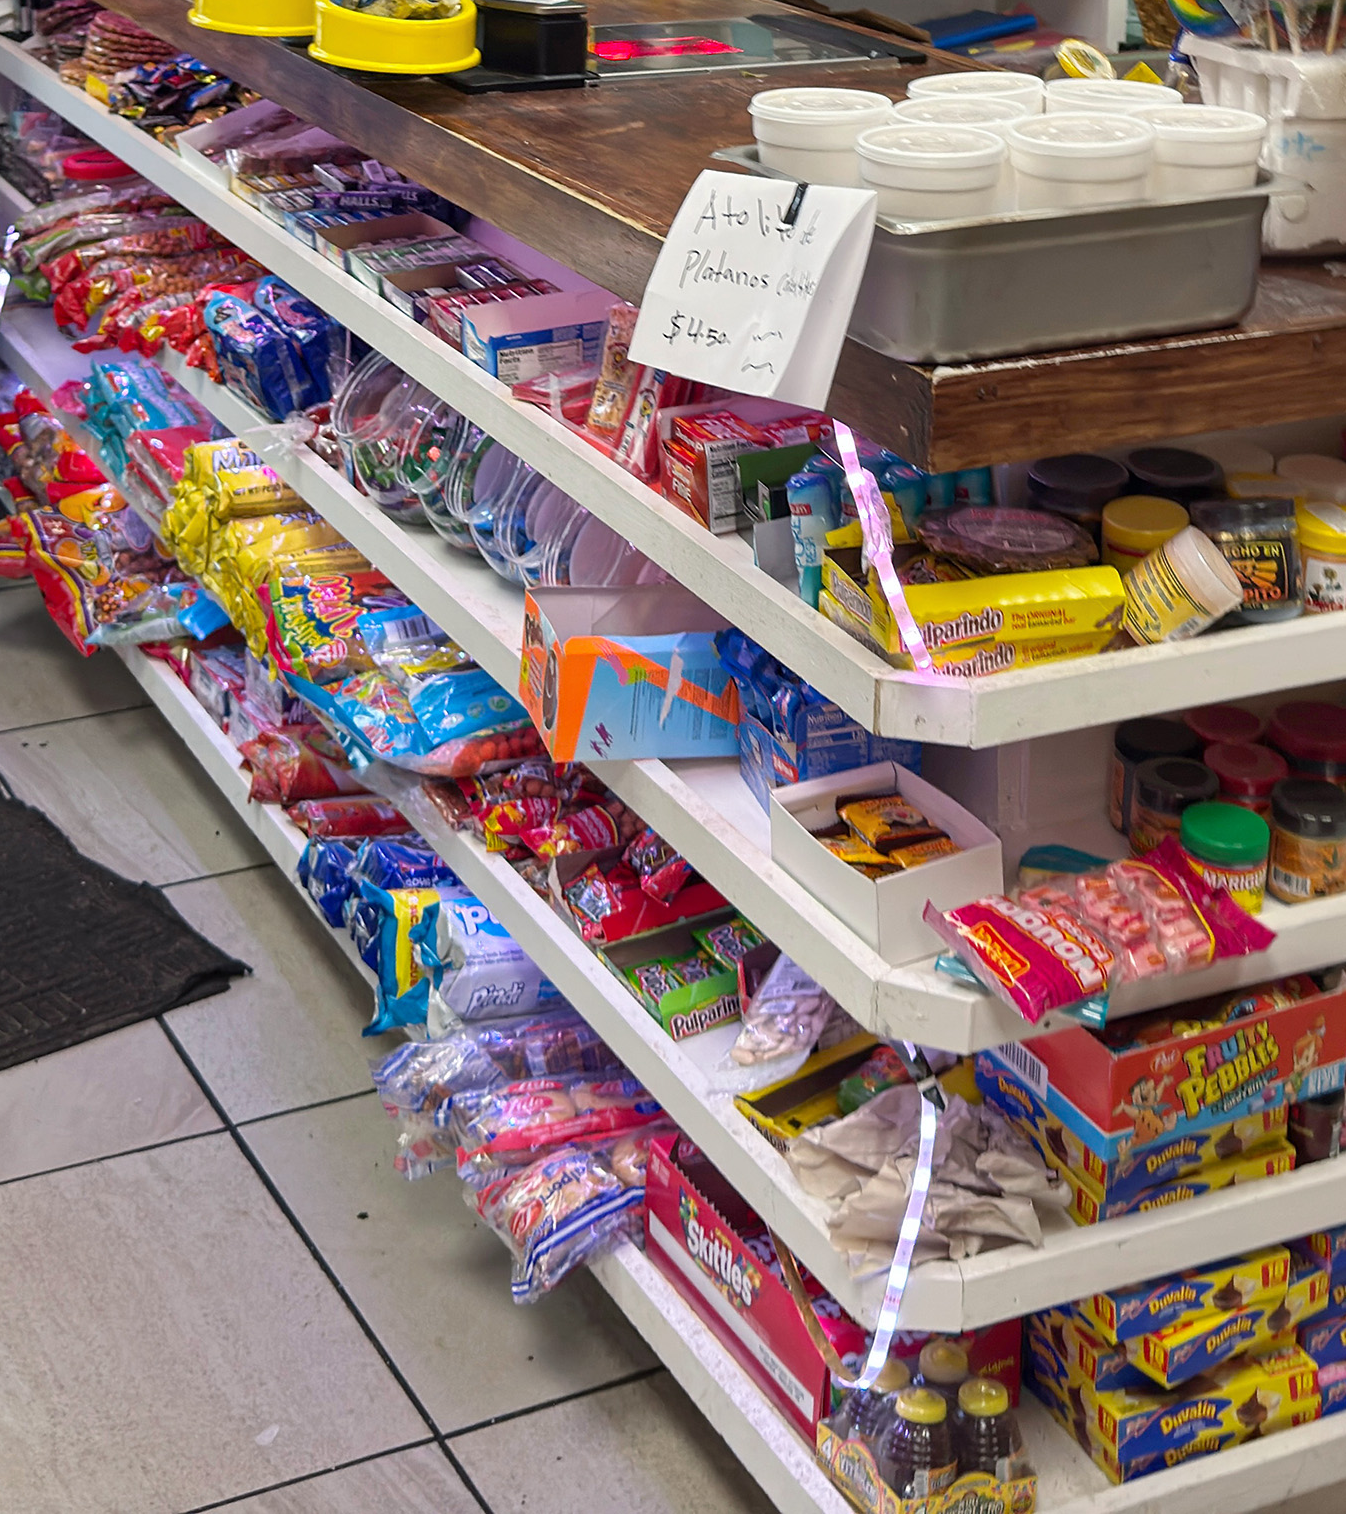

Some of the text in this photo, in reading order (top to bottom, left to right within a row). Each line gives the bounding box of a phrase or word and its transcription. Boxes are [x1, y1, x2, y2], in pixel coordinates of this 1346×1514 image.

[340, 193, 379, 207] HALLS
[498, 346, 535, 359] Nutrition
[498, 355, 522, 367] Facts
[1223, 544, 1261, 560] ECHO
[1243, 586, 1283, 603] PITO
[918, 607, 1004, 652] ulparindo
[670, 995, 740, 1040] Pulparin
[1184, 1022, 1270, 1074] FRUITY
[1176, 1036, 1281, 1119] PEBBLES
[1145, 1139, 1199, 1174] Duvalin
[685, 1220, 755, 1305] Skittles
[1148, 1283, 1200, 1317] Duvalin
[1205, 1314, 1255, 1353] Duvalin
[1159, 1399, 1217, 1435] Duvalin
